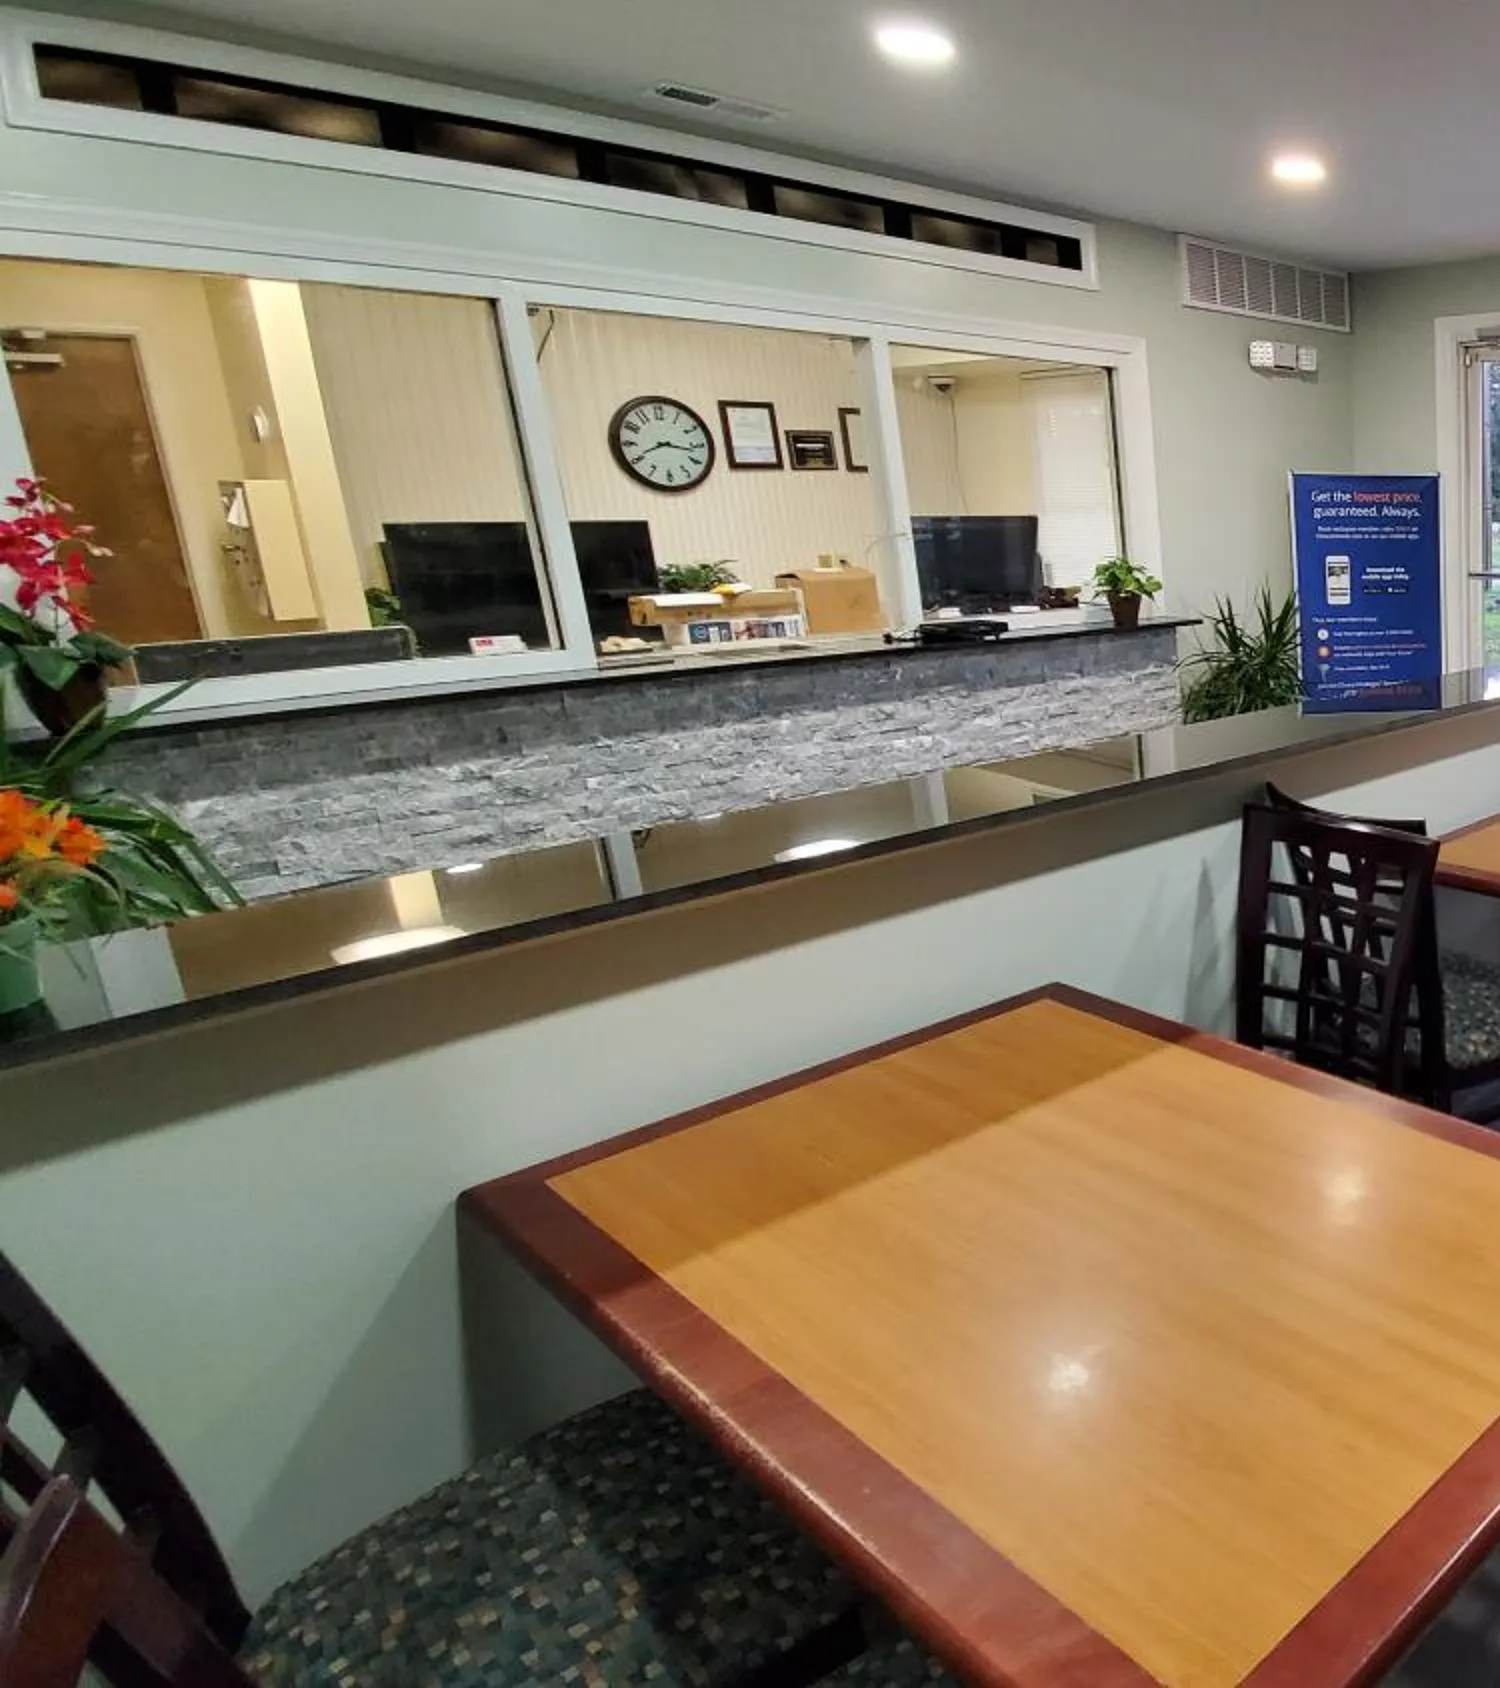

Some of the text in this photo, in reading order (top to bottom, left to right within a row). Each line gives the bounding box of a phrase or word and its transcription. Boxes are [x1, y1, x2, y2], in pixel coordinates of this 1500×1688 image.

[634, 408, 650, 426] 11
[653, 404, 664, 421] 12
[623, 419, 641, 435] 10
[683, 424, 698, 435] 2
[689, 441, 705, 449] 3
[631, 454, 645, 465] 8
[647, 463, 657, 478] 7
[666, 469, 674, 483] 6
[680, 464, 691, 479] 5
[1311, 491, 1331, 502] Get
[1333, 490, 1352, 502] the
[1353, 491, 1390, 503] lowest
